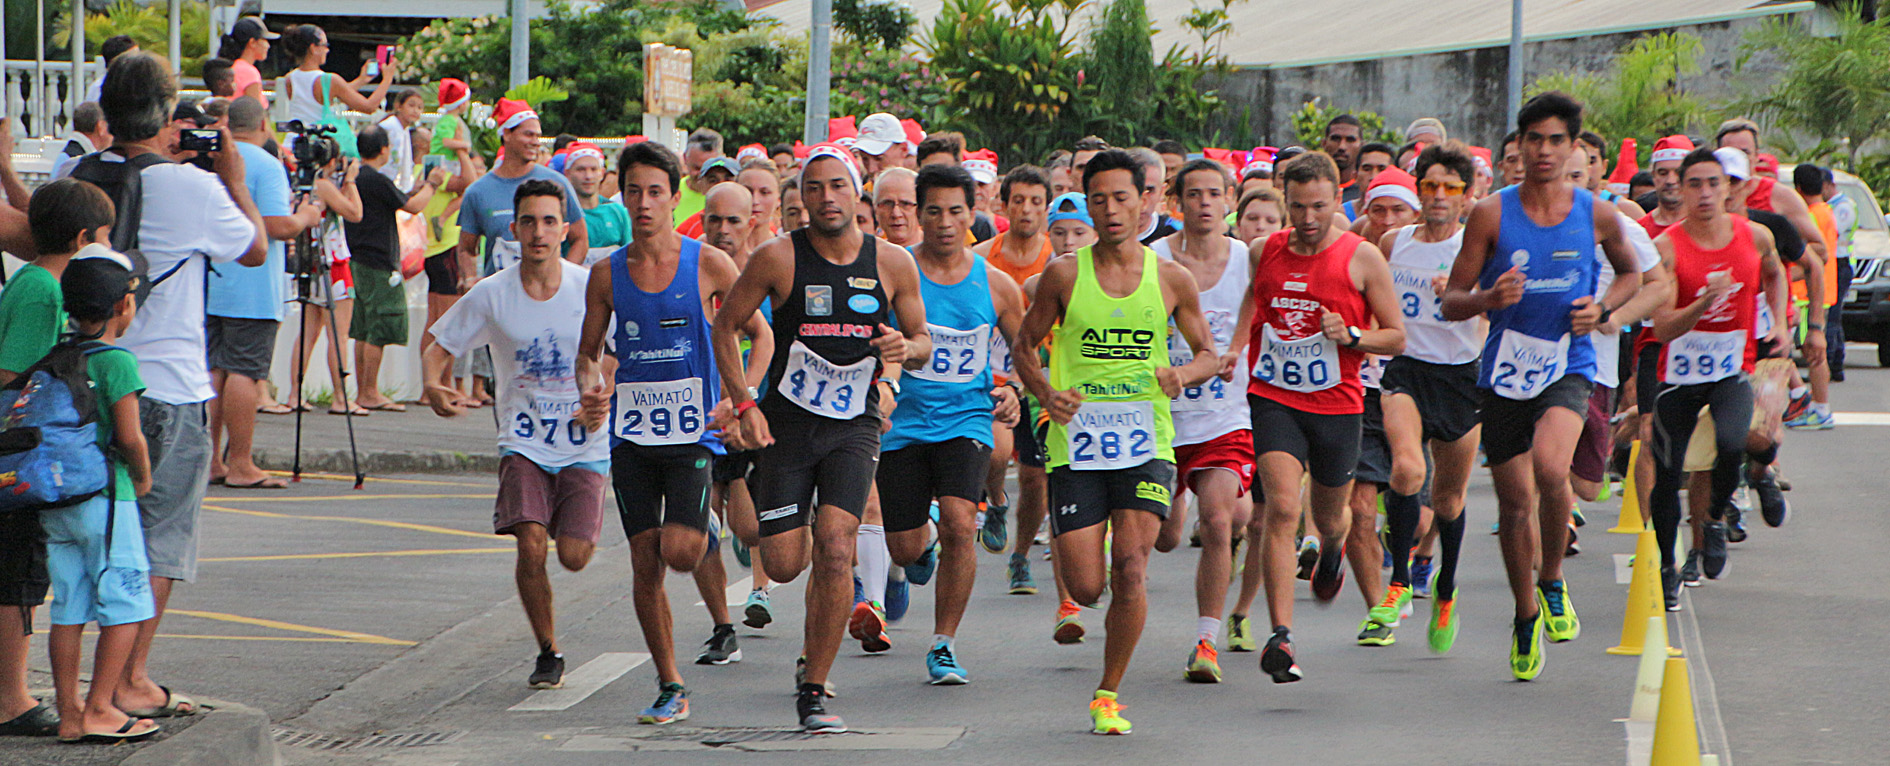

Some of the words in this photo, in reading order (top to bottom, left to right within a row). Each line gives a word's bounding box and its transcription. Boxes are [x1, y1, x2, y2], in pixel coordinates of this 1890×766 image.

[1271, 297, 1320, 312] ASCEP
[1081, 328, 1154, 344] AITO
[911, 347, 976, 374] 62
[1081, 345, 1152, 358] SPORT
[1256, 353, 1328, 386] 360
[1673, 354, 1733, 377] 394
[632, 387, 693, 406] VAIMATO
[790, 368, 854, 413] 413
[514, 411, 587, 446] 370
[622, 405, 700, 438] 296
[1073, 429, 1151, 462] 282
